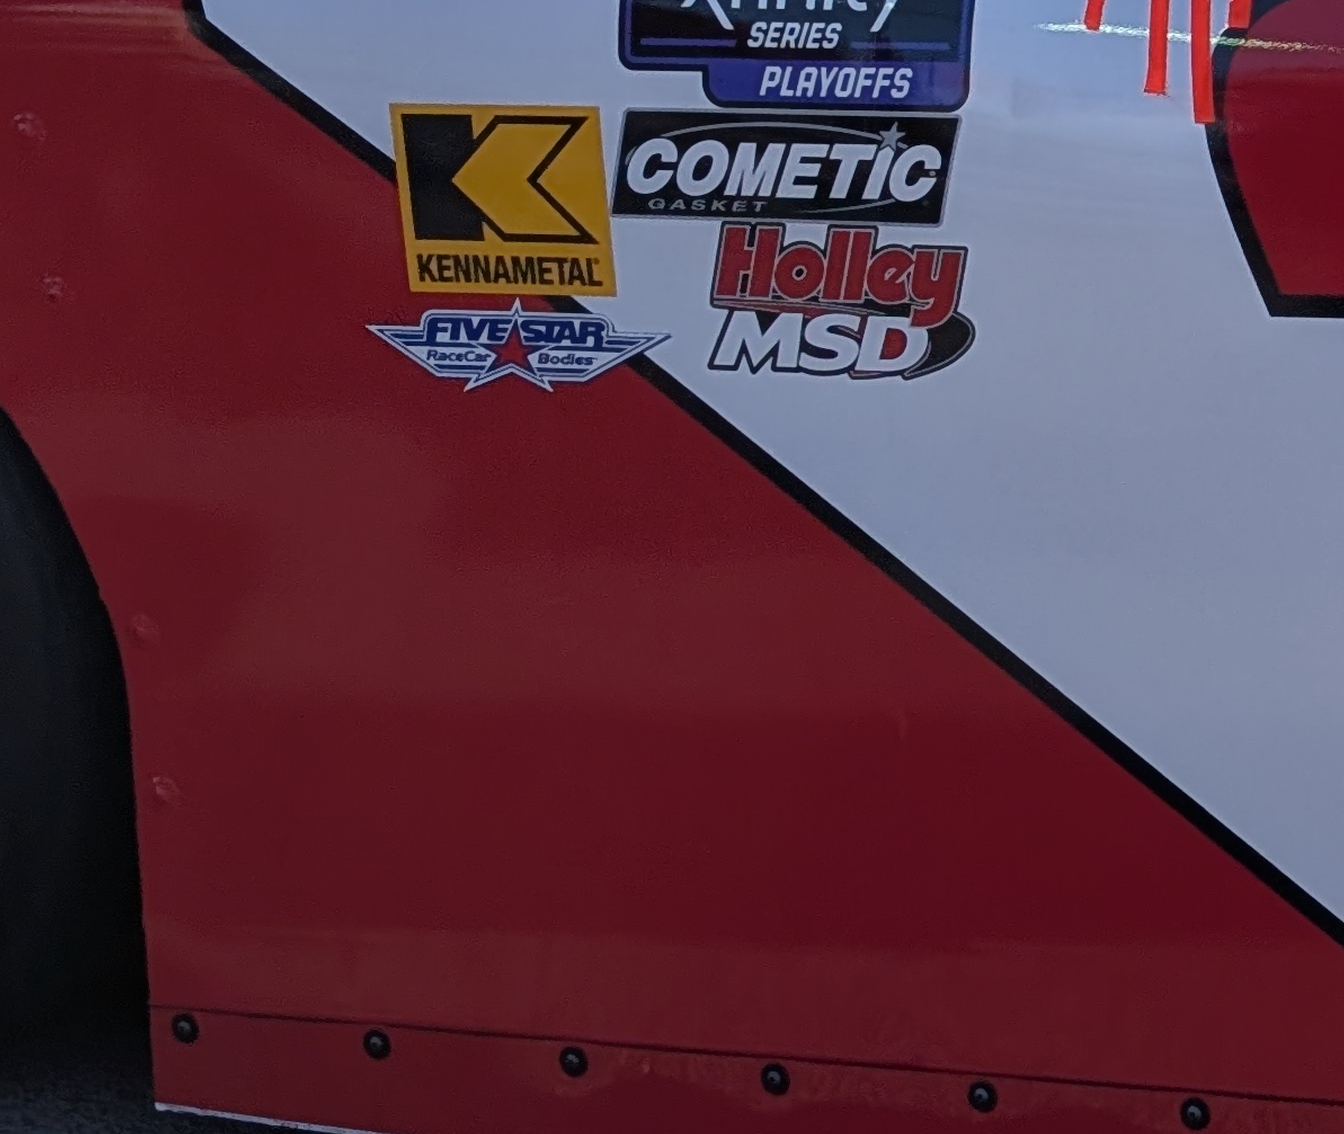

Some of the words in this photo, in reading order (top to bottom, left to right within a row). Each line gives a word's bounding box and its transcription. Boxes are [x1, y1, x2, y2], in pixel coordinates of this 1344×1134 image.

[747, 22, 843, 50] SERIES
[759, 66, 914, 99] PLAYOFFS
[626, 137, 942, 203] COMETIC
[648, 198, 769, 214] GASKET
[416, 253, 603, 287] KENNAMETAL
[710, 221, 969, 329] Holley
[425, 317, 511, 345] FIVE
[519, 319, 606, 349] STAR
[708, 309, 934, 378] MSD
